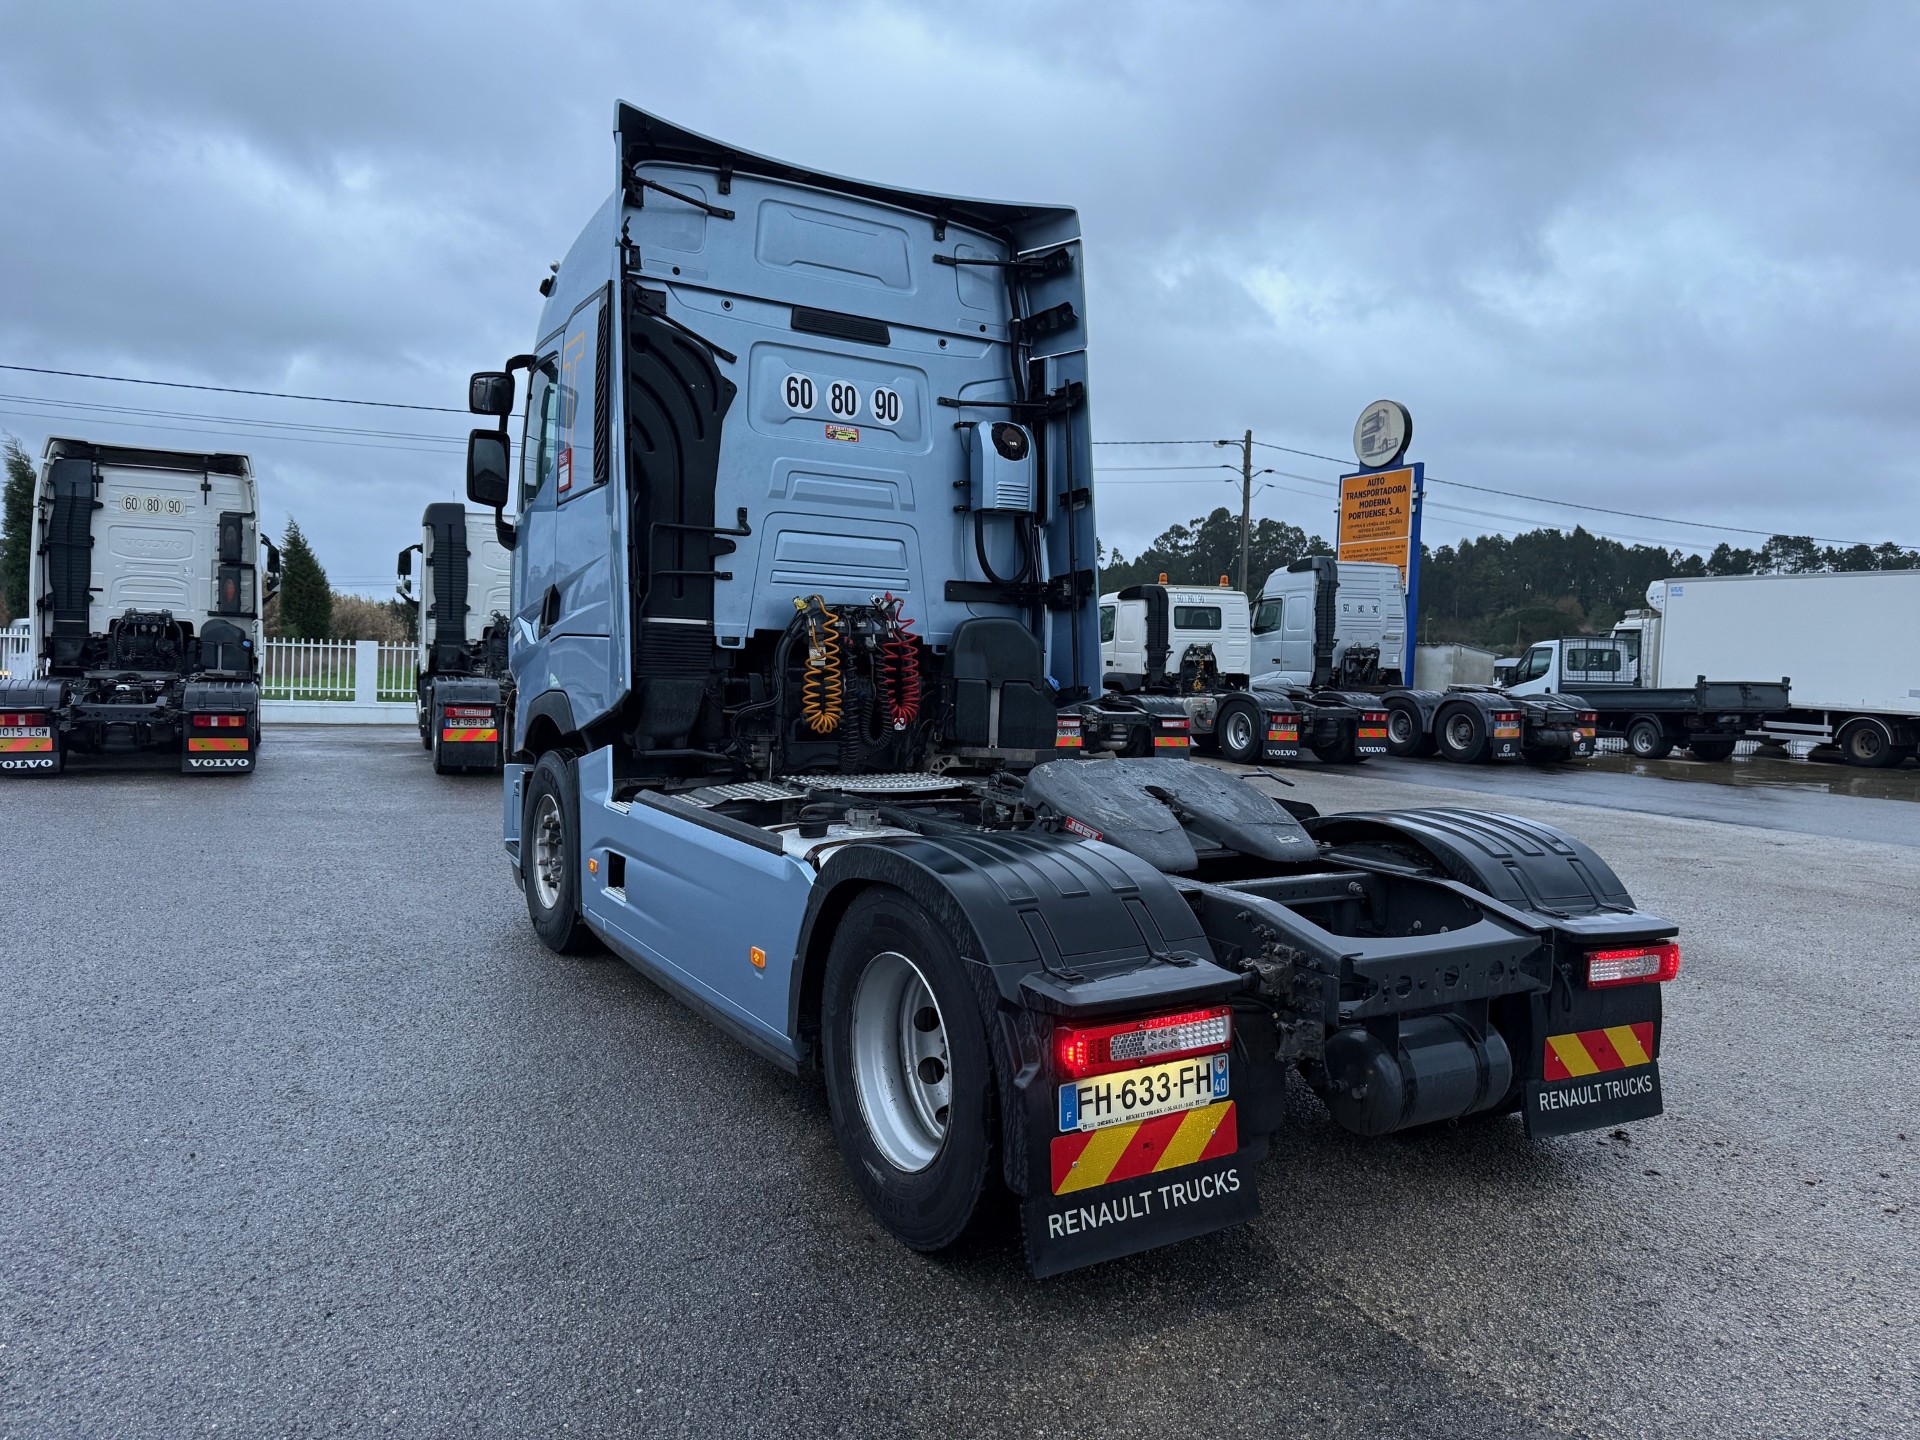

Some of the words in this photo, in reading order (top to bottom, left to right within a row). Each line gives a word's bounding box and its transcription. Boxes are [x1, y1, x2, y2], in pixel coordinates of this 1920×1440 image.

[786, 376, 813, 410] 60
[831, 383, 856, 416] 80
[874, 389, 898, 422] 90
[1367, 477, 1385, 487] AUTO
[1346, 485, 1407, 500] TRANSPORTADORA
[125, 497, 138, 510] 60
[147, 498, 159, 512] 80
[168, 500, 181, 513] 90
[1359, 498, 1391, 509] MODERNA
[1348, 509, 1388, 520] PORTUENSE,
[1389, 507, 1402, 516] S.A.
[1342, 603, 1350, 613] 60
[1357, 604, 1365, 614] 80
[0, 727, 23, 737] 015
[29, 727, 48, 737] LGW
[0, 759, 53, 769] OLVO
[188, 758, 250, 768] VOLVO
[1068, 820, 1099, 841] JOST
[1077, 1062, 1213, 1121] FH-633-FH
[1213, 1077, 1227, 1093] 40
[1539, 1083, 1601, 1112] RENAULT
[1605, 1075, 1653, 1100] TRUCKS
[1066, 1111, 1072, 1122] F
[1048, 1190, 1152, 1239] RENAULT
[1157, 1168, 1241, 1210] TRUCKS
